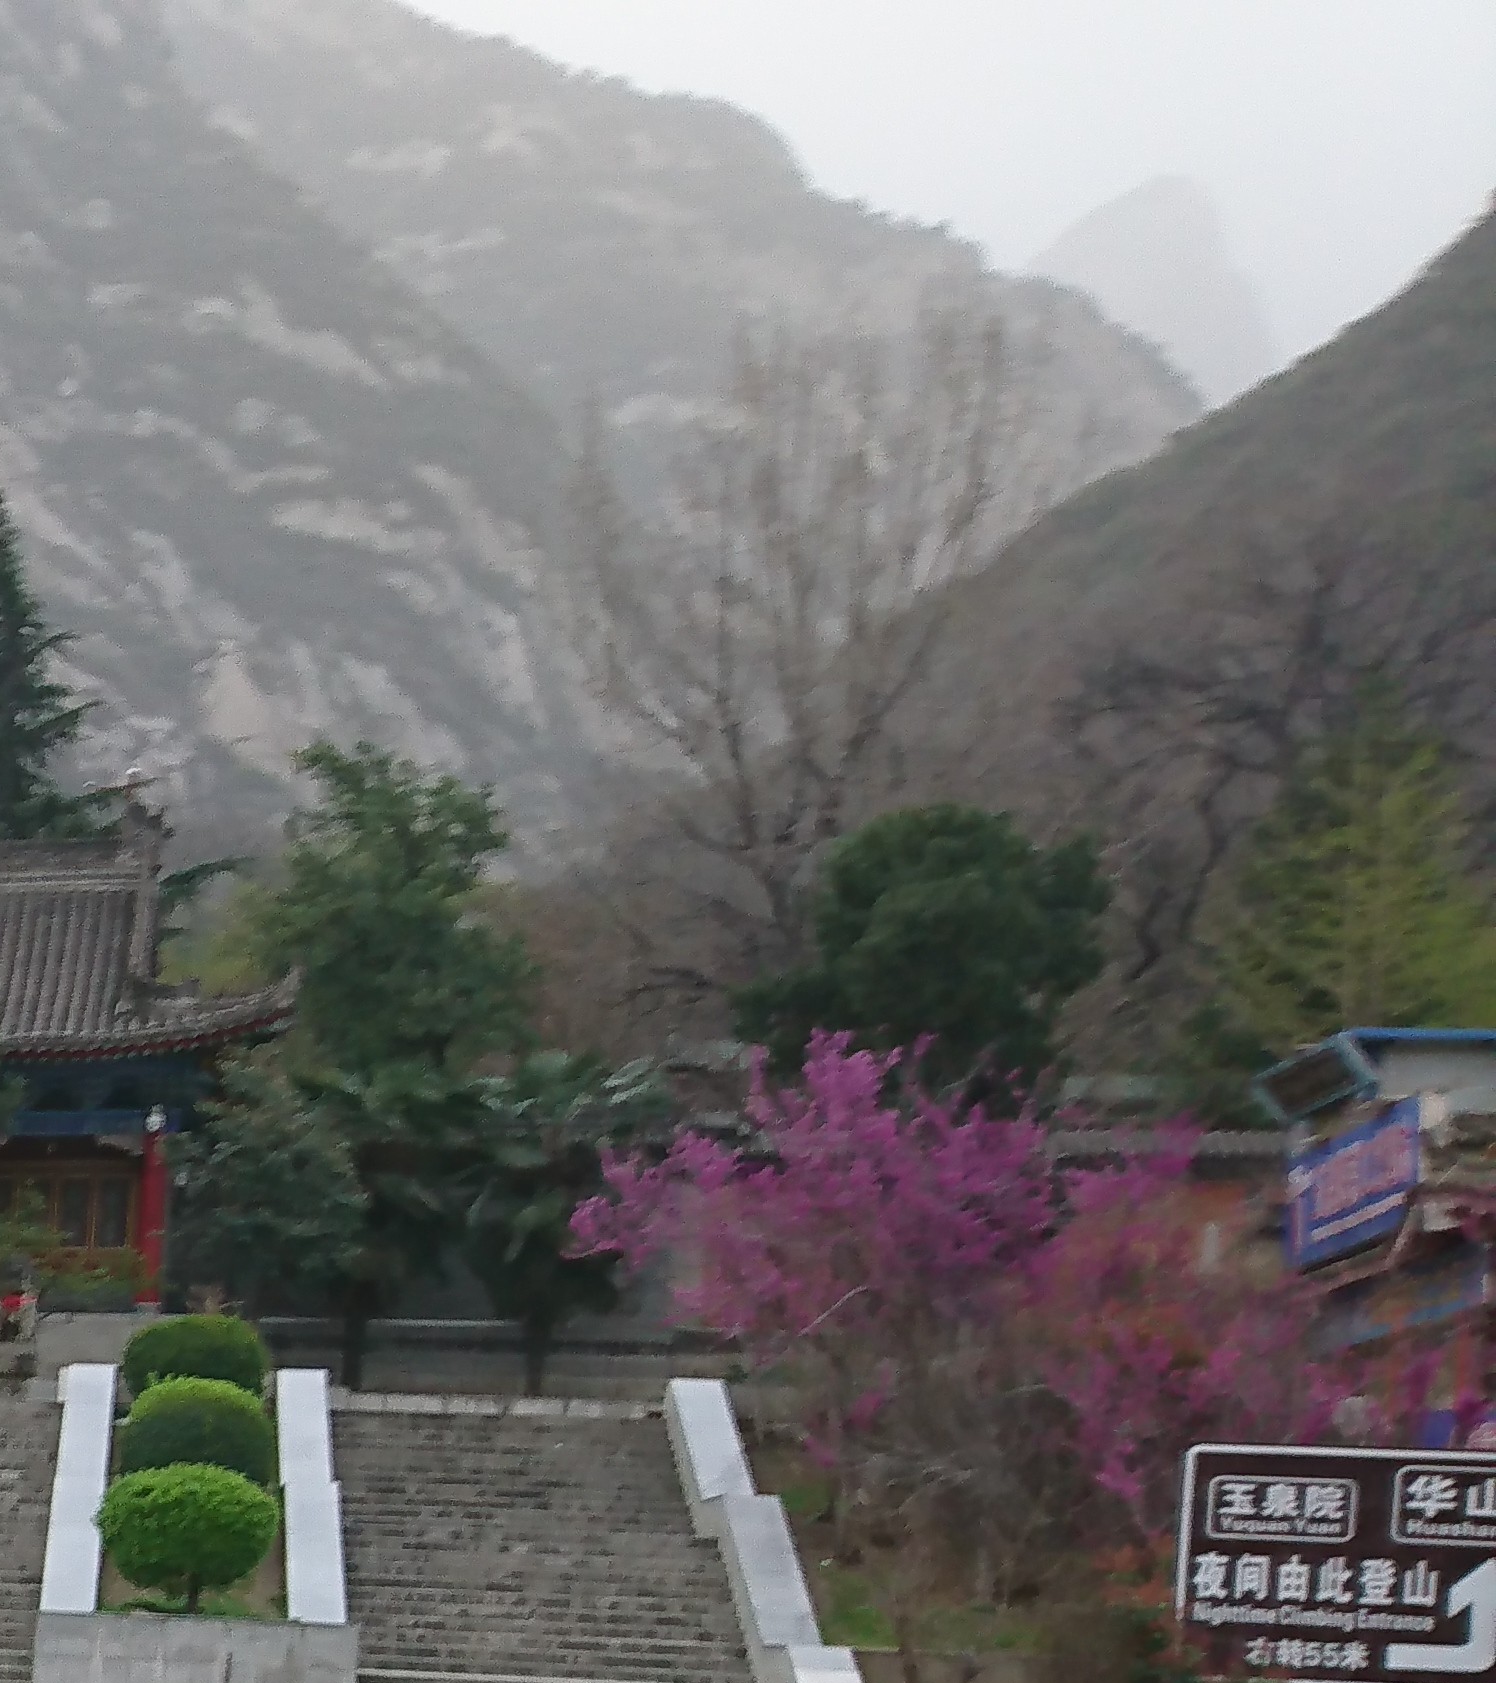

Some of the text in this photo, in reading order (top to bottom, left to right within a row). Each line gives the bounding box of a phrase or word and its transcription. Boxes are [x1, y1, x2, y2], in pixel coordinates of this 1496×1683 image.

[1217, 1481, 1349, 1519] 玉泉院
[1193, 1551, 1441, 1607] 夜间由此登山
[1244, 1636, 1370, 1671] 右转55米
